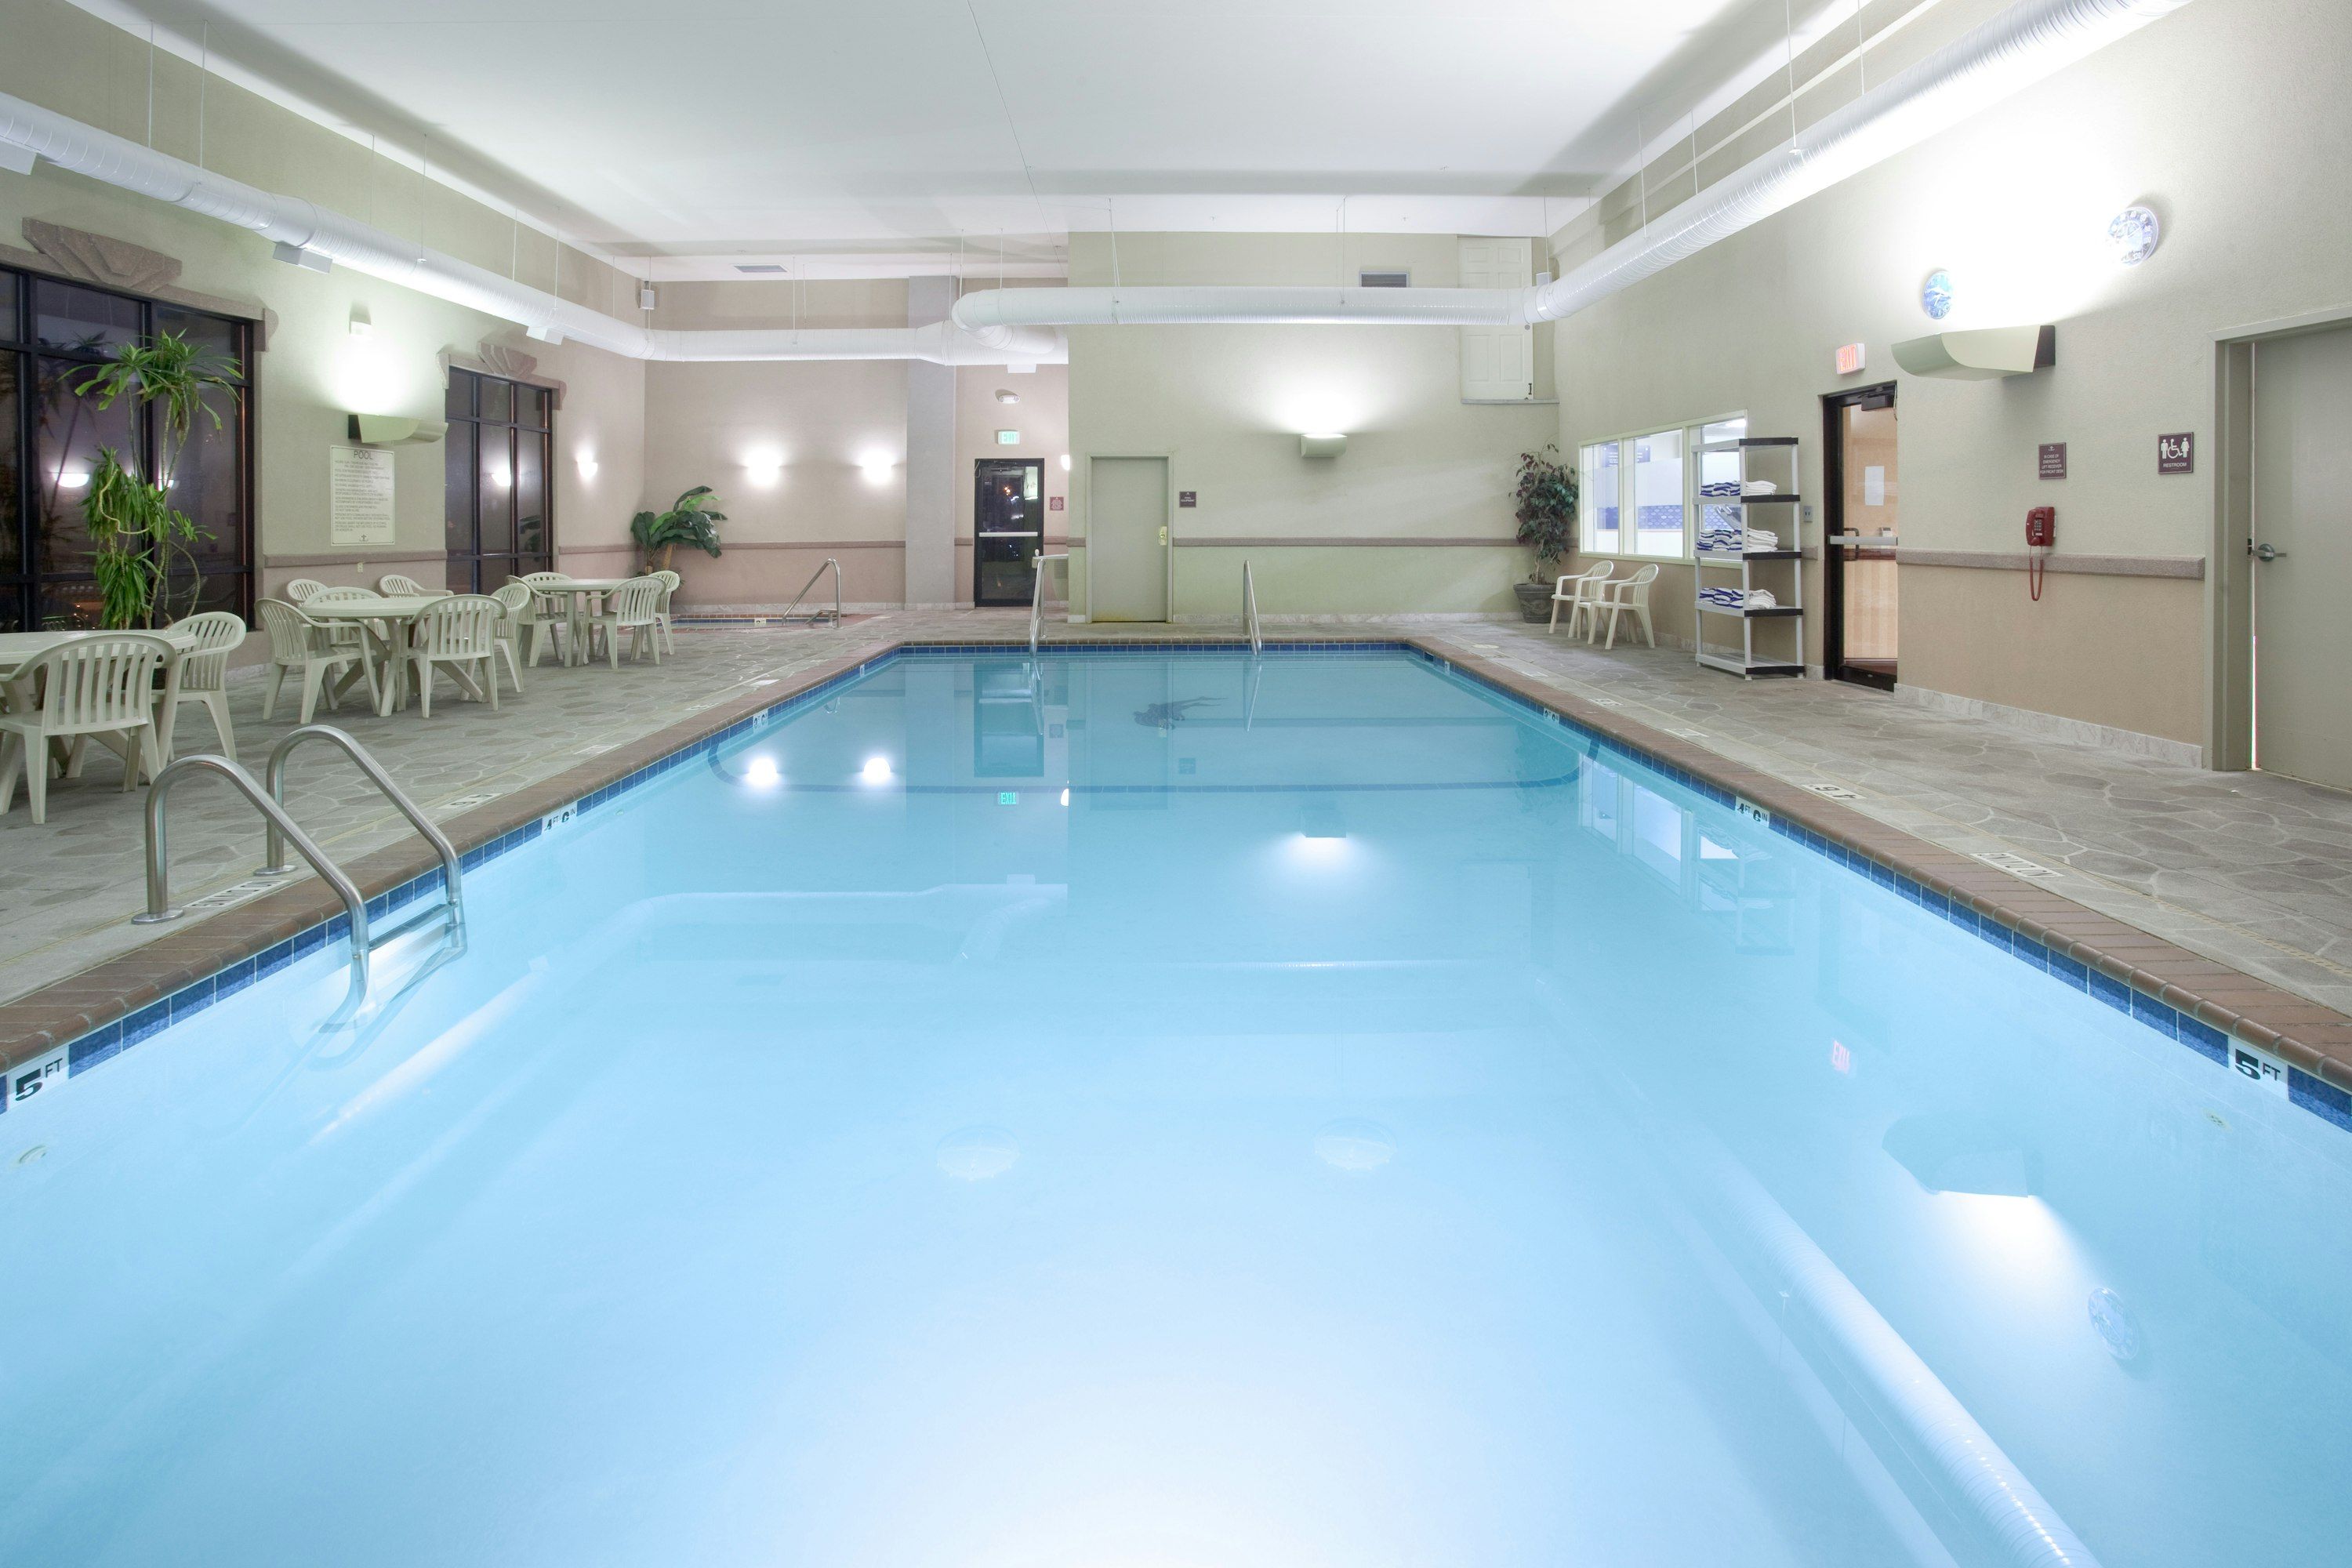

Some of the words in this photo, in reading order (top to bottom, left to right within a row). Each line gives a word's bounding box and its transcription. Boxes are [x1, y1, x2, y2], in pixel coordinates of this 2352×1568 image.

[354, 450, 374, 460] POOL
[15, 1068, 43, 1102] 5
[45, 1058, 63, 1078] FT
[2234, 1048, 2261, 1080] 5
[2263, 1062, 2281, 1081] FT
